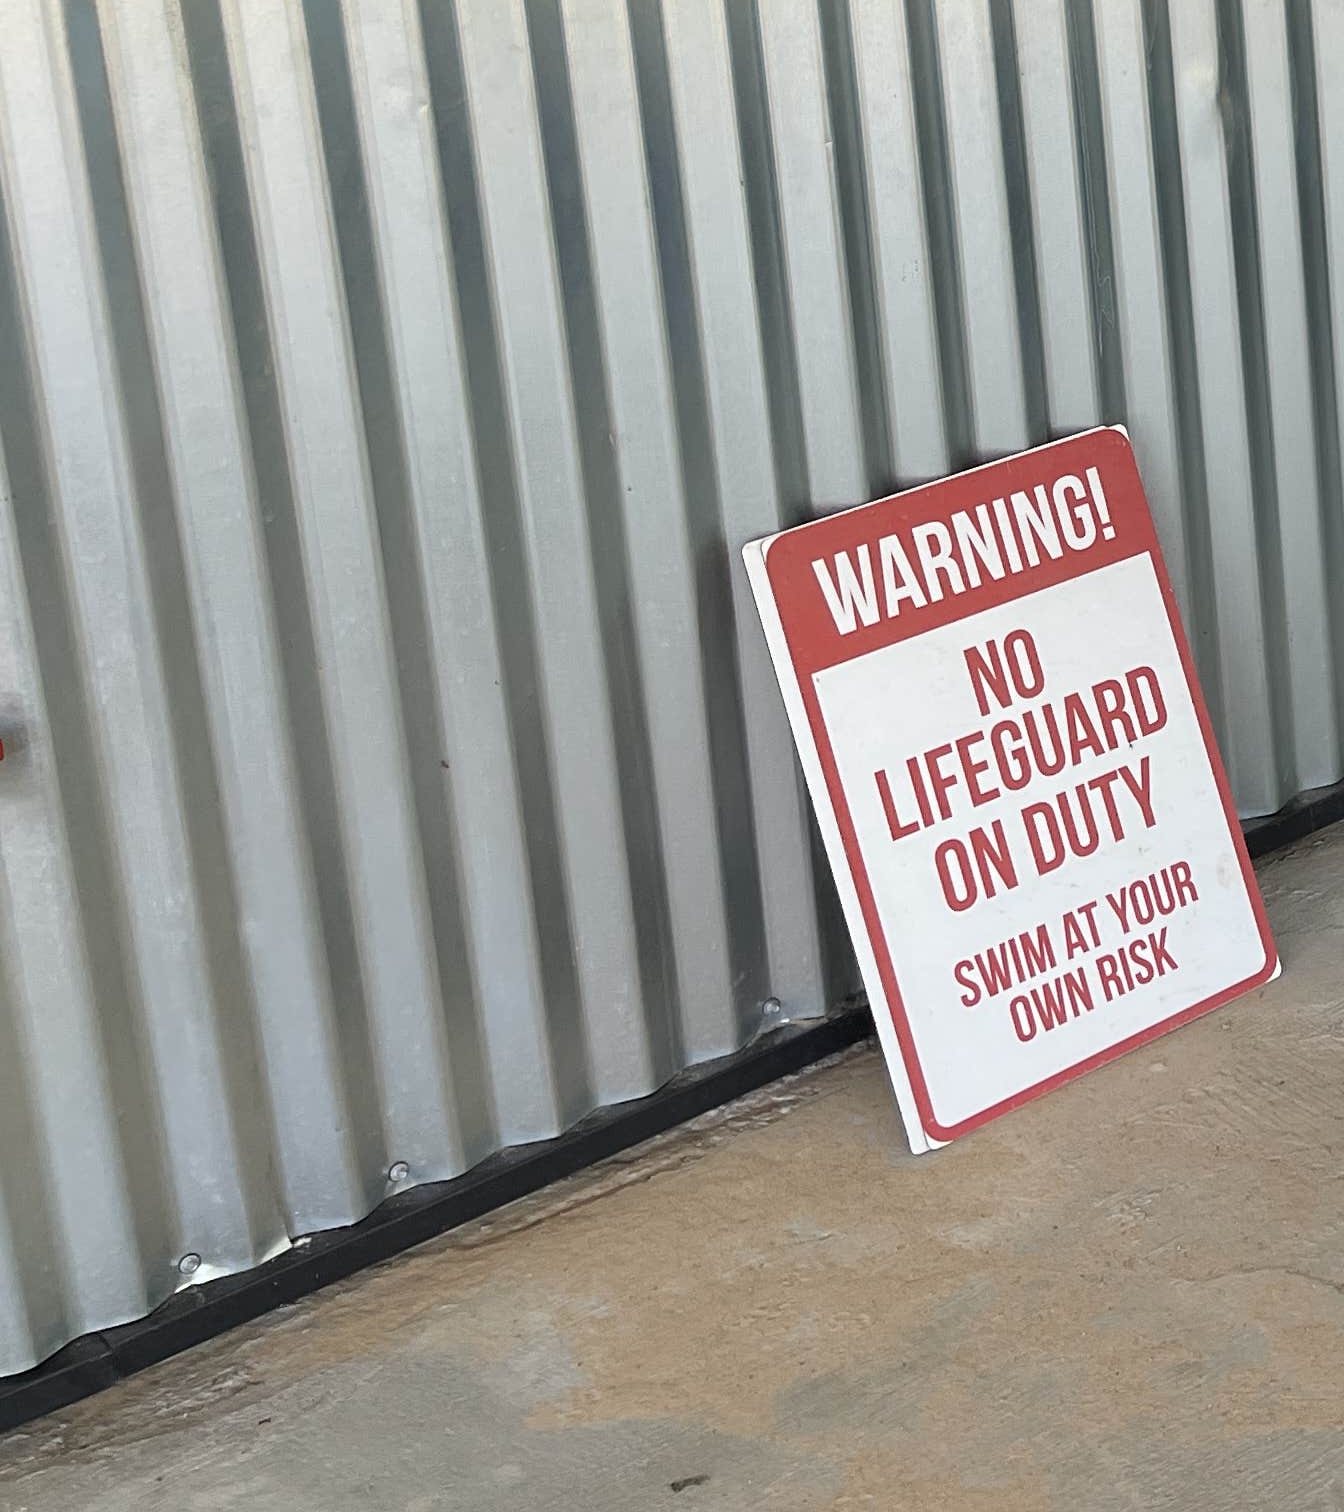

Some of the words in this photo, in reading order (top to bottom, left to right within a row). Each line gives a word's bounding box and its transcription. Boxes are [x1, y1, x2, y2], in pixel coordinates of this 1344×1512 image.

[812, 466, 1117, 637] WARNING!
[962, 628, 1046, 717] NO
[873, 664, 1169, 842] LIFEGUARD
[933, 818, 1019, 913] ON
[1021, 755, 1158, 877] DUTY
[953, 923, 1056, 1008] SWIM
[1063, 900, 1105, 957] AT
[1110, 860, 1200, 928] YOUR
[1010, 969, 1096, 1044] OWN
[1099, 926, 1179, 1003] RISK
